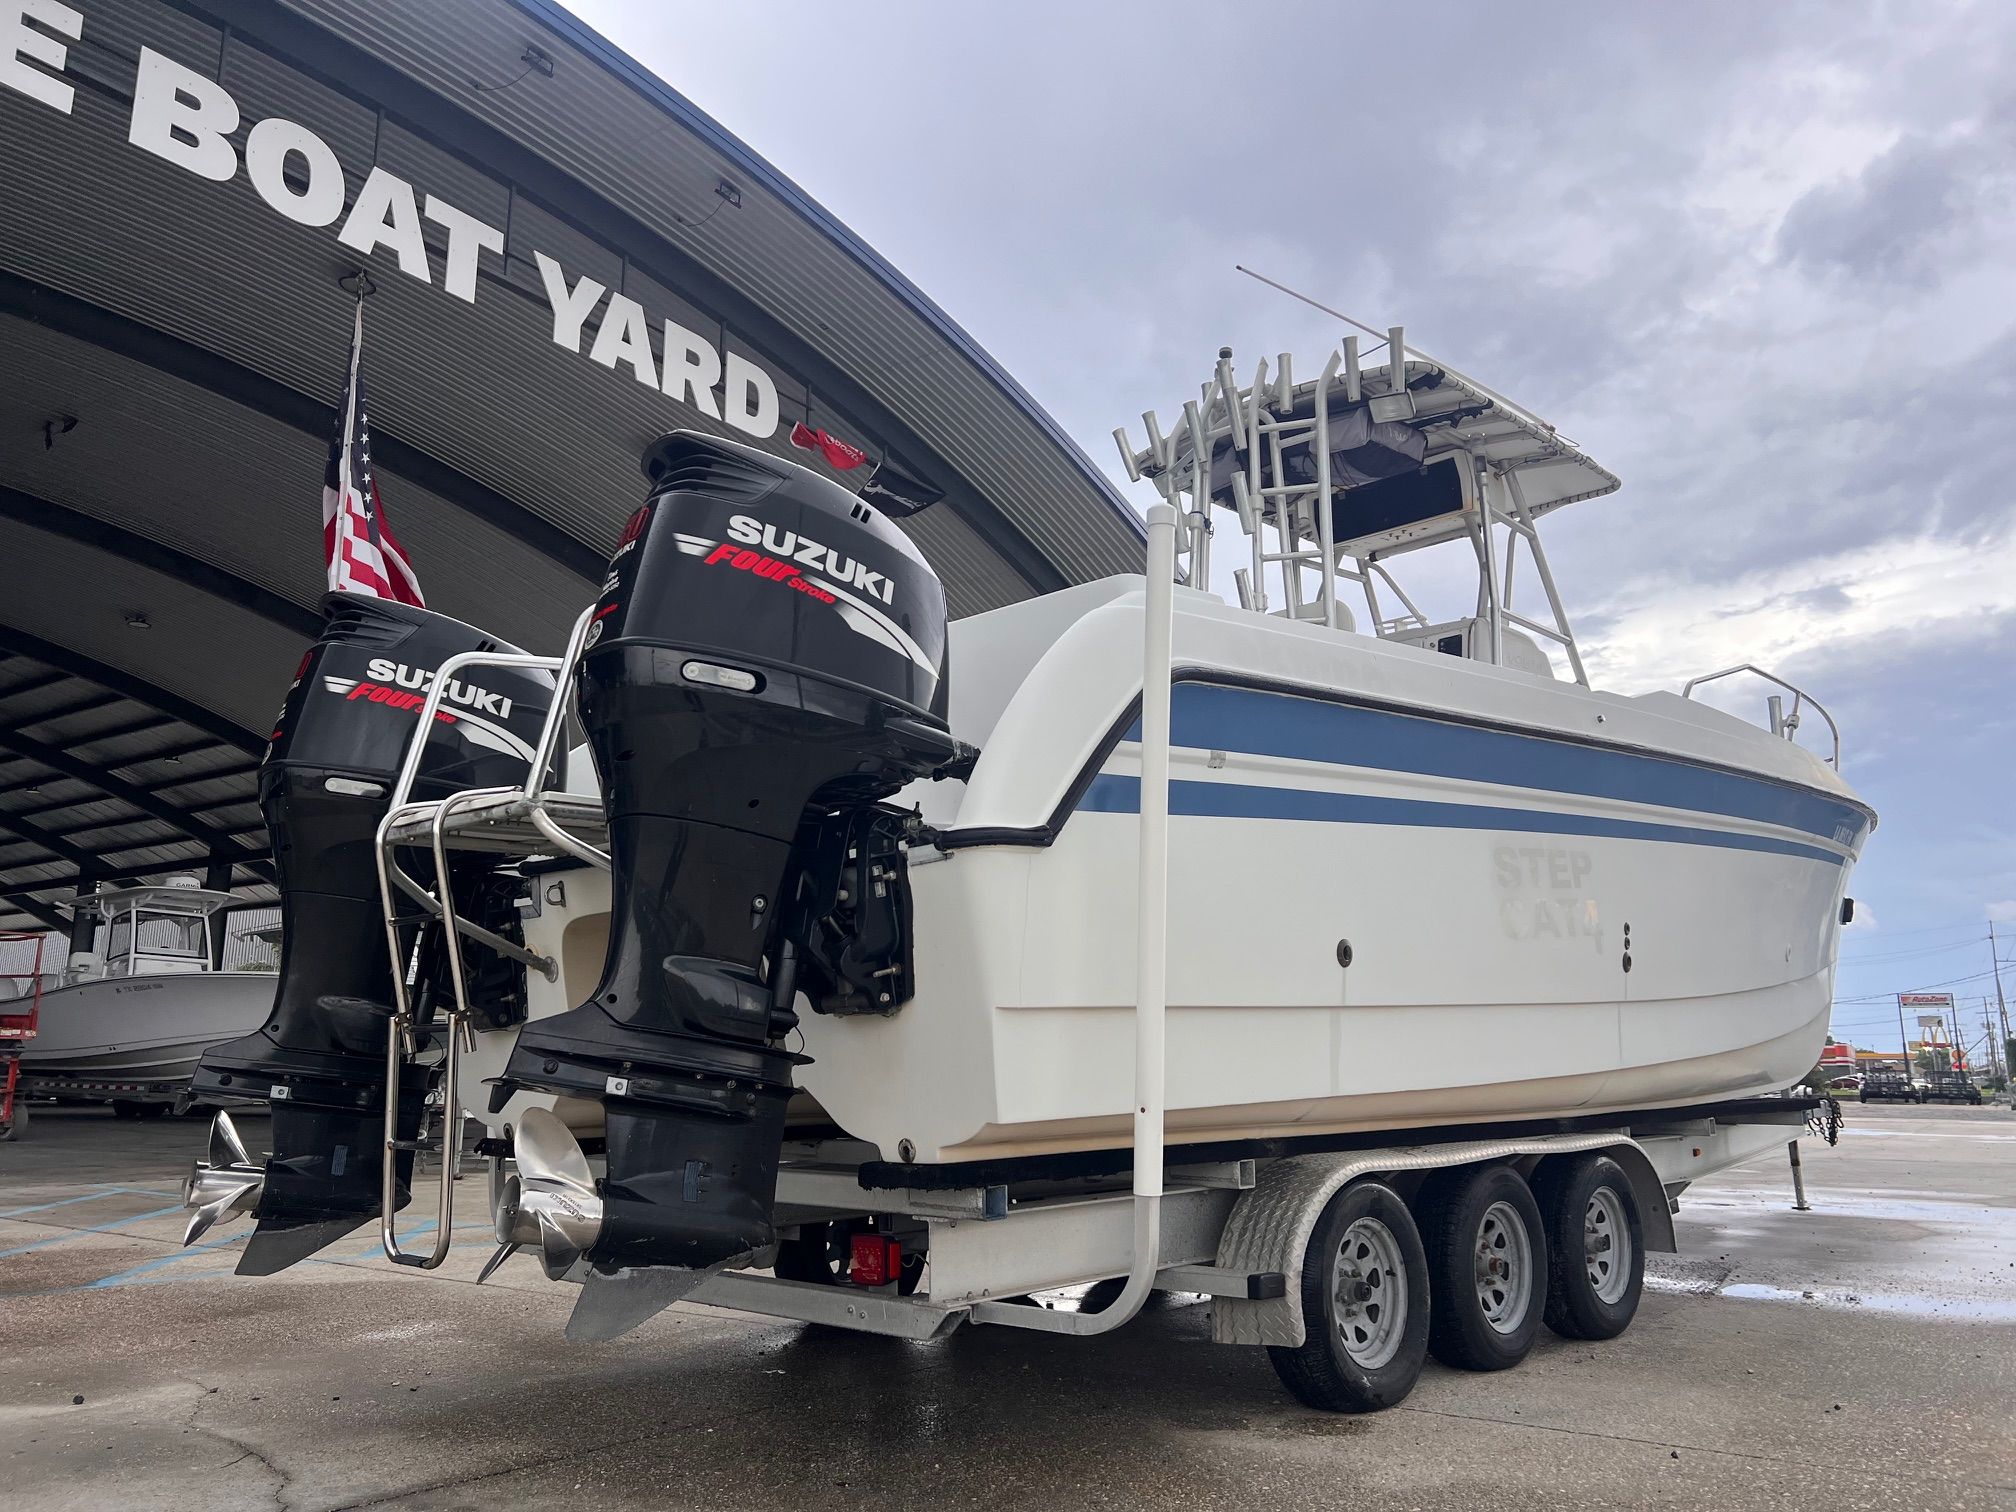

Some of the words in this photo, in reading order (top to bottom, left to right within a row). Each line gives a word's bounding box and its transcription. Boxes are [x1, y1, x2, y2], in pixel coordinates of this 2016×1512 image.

[128, 45, 504, 304] BOAT
[533, 250, 781, 440] YARD
[726, 515, 895, 606] SUZUKI
[1493, 846, 1592, 889] STEP
